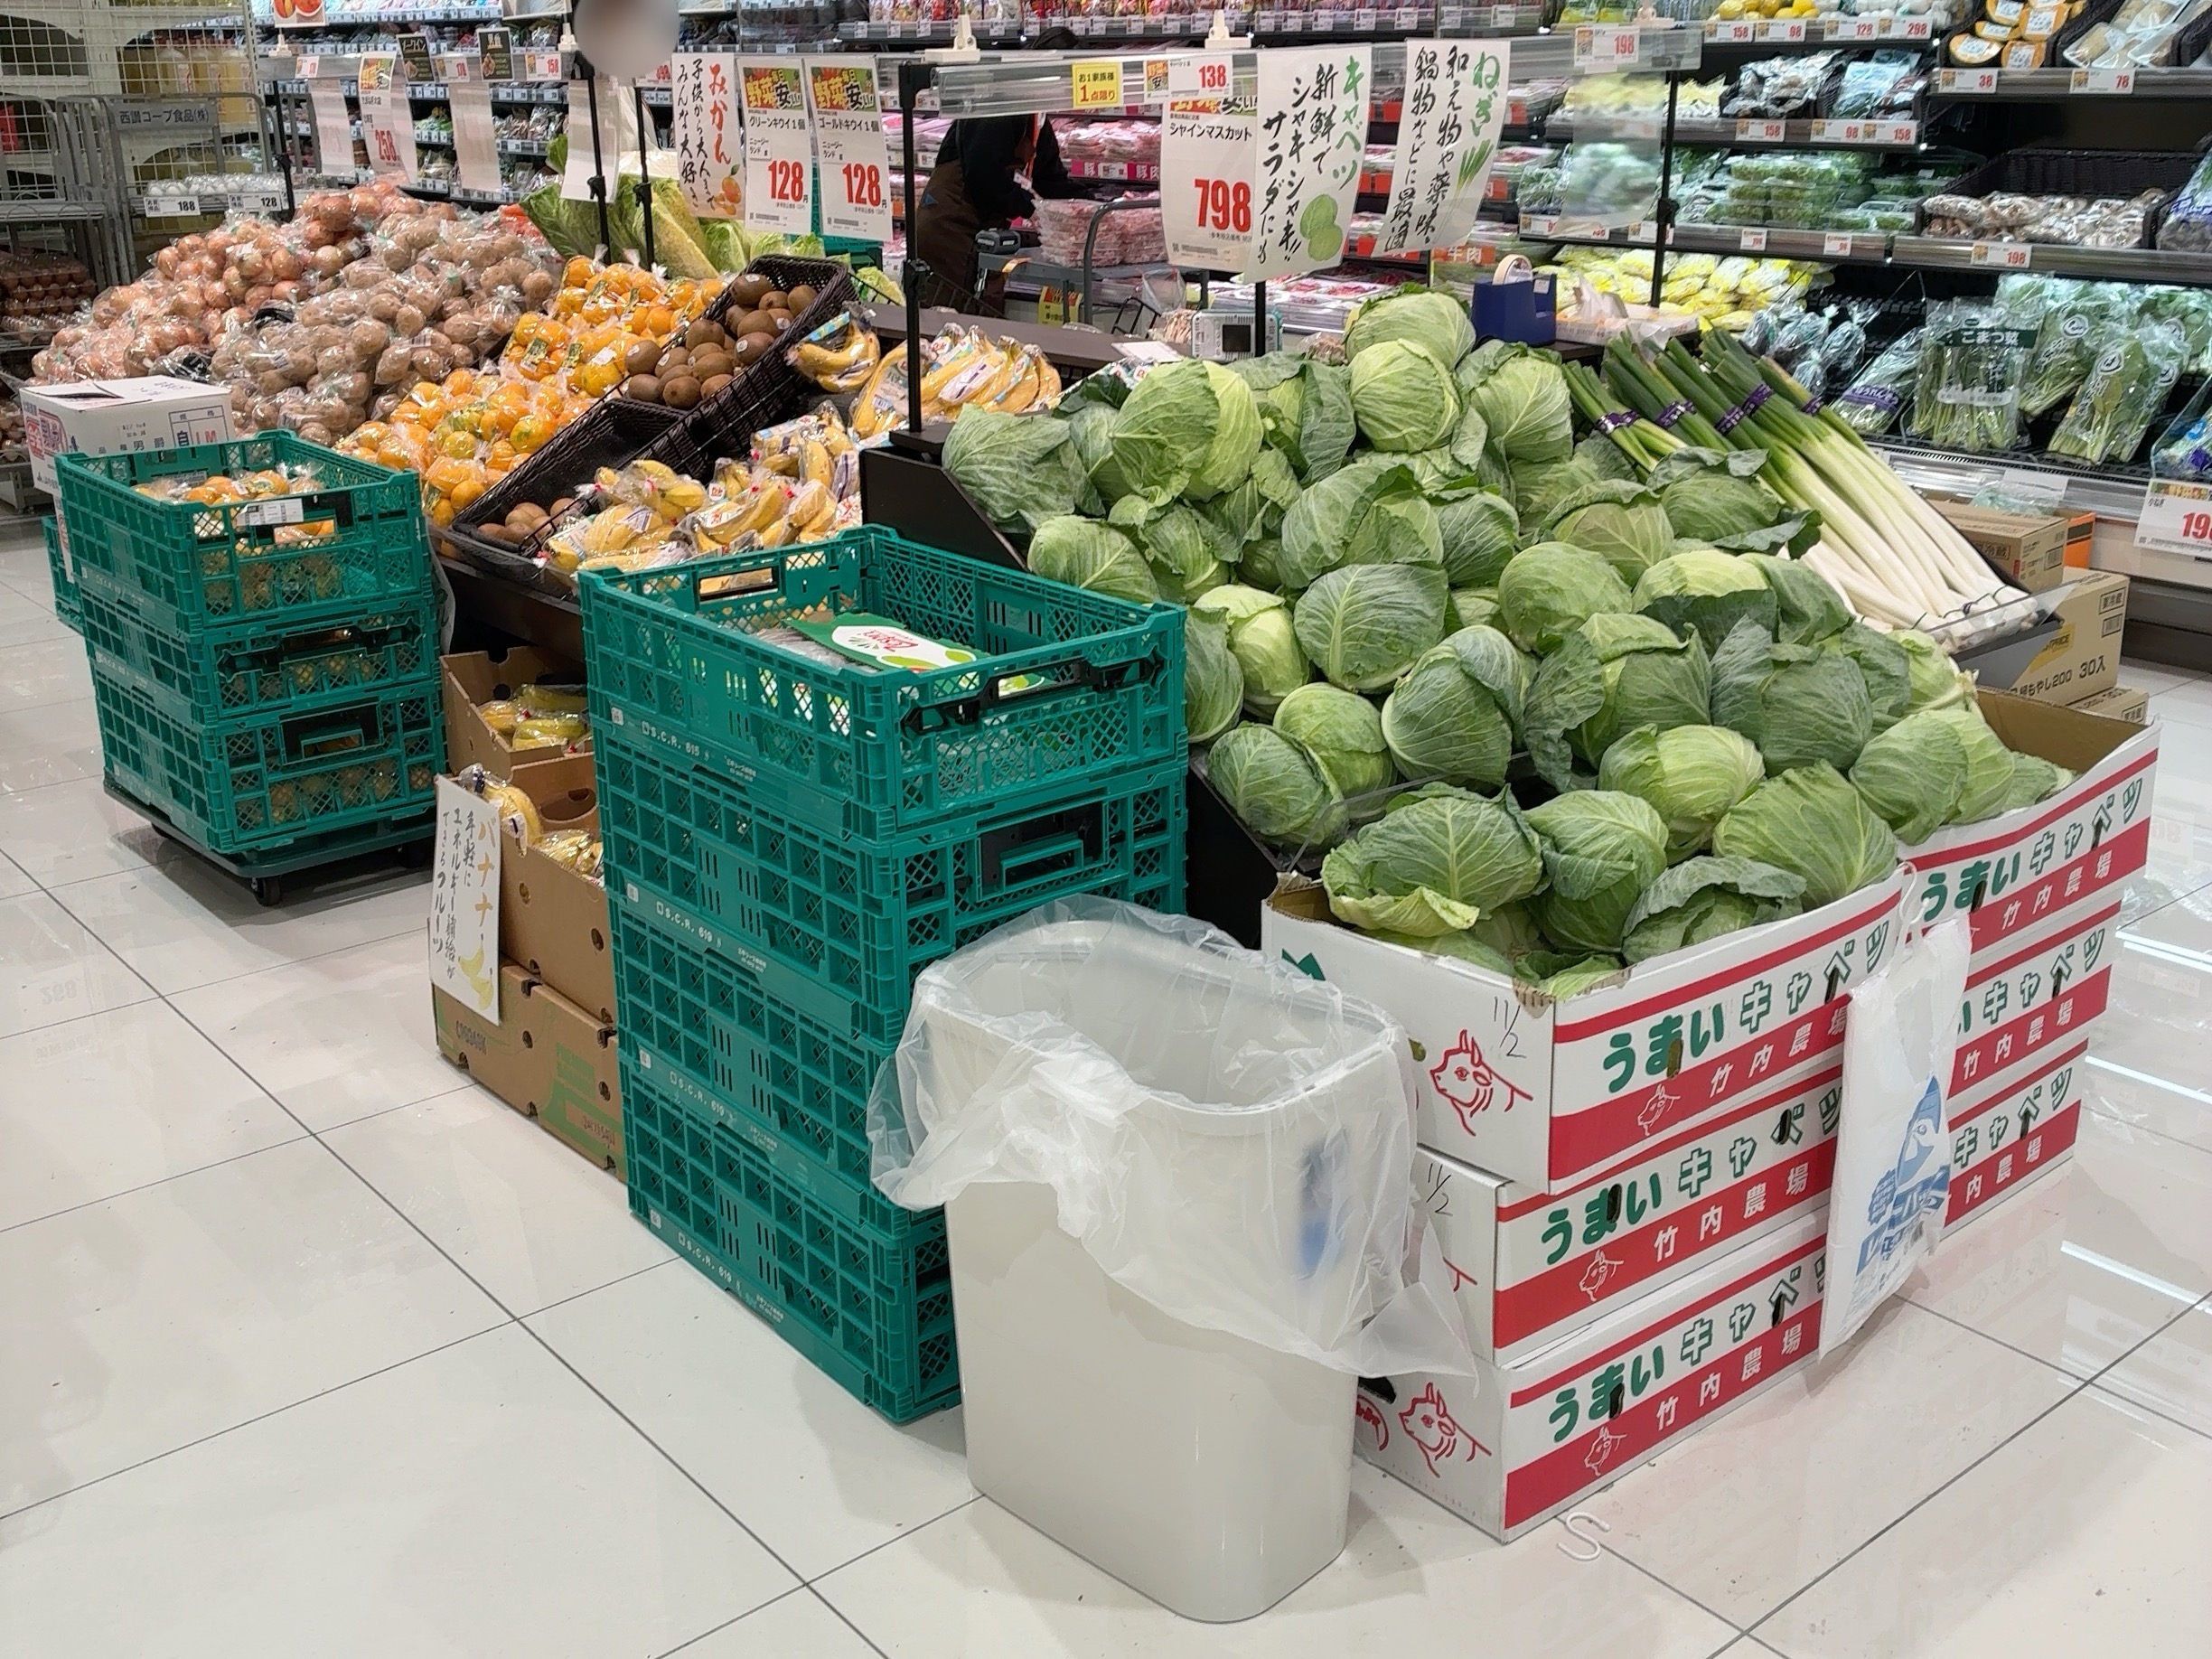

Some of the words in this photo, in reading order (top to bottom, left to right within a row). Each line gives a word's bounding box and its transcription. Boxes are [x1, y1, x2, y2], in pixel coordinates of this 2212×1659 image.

[1614, 33, 1635, 54] 198
[1078, 72, 1115, 82] お1家族様
[1080, 84, 1116, 102] 1点限り
[1198, 64, 1227, 89] 138
[1469, 51, 1501, 136] ねぎ
[677, 63, 699, 210] みんな大好き
[708, 62, 731, 165] みかん
[1168, 123, 1252, 142] シャインマスカット
[1309, 62, 1338, 175] 新鮮で
[1332, 54, 1365, 191] キャベツ
[374, 129, 396, 162] 258
[1383, 45, 1440, 252] 鍋物などに最適
[177, 201, 196, 211] 188
[260, 197, 277, 207] 128
[767, 159, 804, 202] 128
[802, 195, 809, 204] 円
[841, 163, 882, 207] 128
[881, 199, 888, 209] 円
[1194, 178, 1251, 233] 798
[1257, 109, 1288, 265] サラダにも
[1447, 247, 1482, 263] 牛肉
[1960, 330, 2020, 346] こまつ菜
[2182, 511, 2212, 540] 19
[2078, 654, 2106, 679] 30入
[473, 817, 498, 928] バナナ
[1920, 777, 2144, 923] うまいキャベツ
[1999, 848, 2114, 932] 竹内農場
[1493, 996, 1527, 1060] 11/2
[1601, 917, 1890, 1094] うまいキャベツ
[1709, 1003, 1849, 1098] 竹内農場
[1963, 996, 2075, 1082] 竹内農場
[1426, 1162, 1454, 1218] 11/2
[1653, 1162, 1809, 1263] 竹内農場
[1655, 1321, 1804, 1432] 竹内農場
